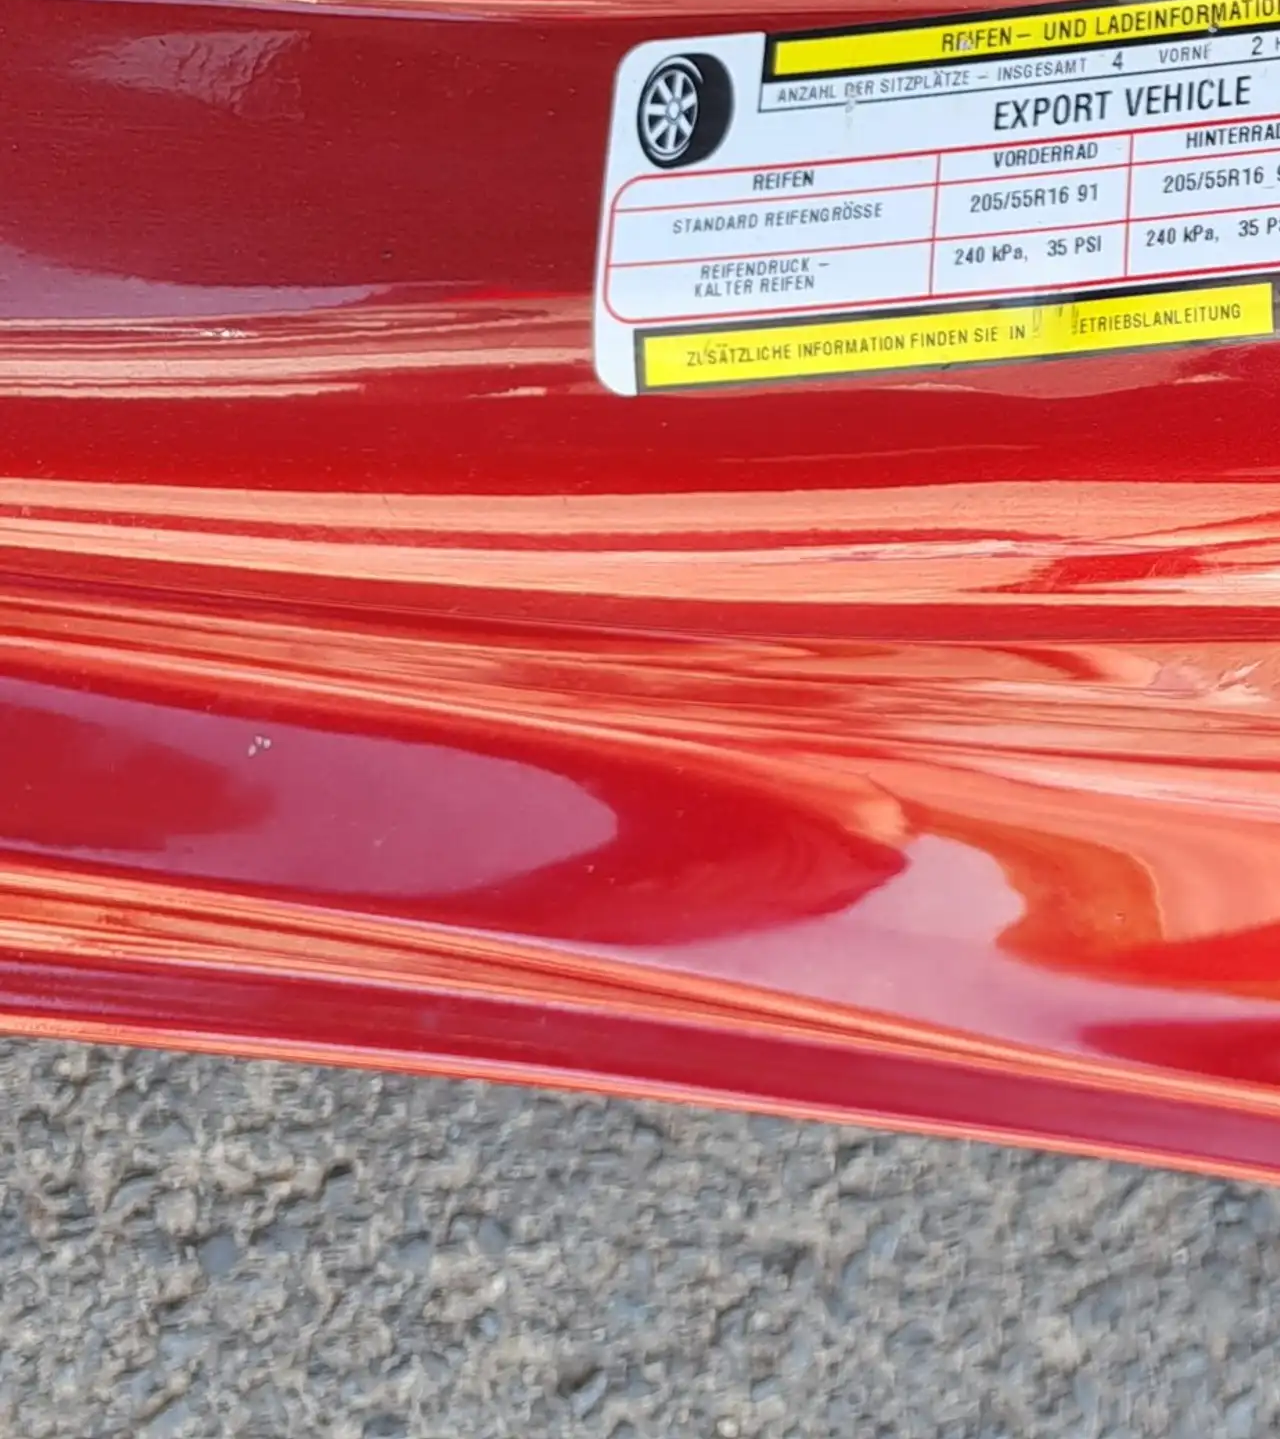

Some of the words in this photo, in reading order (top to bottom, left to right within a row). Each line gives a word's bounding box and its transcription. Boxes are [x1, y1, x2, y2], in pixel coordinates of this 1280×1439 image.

[1044, 18, 1087, 41] UND
[777, 83, 836, 103] ANZAHL
[844, 78, 874, 98] DER
[880, 70, 971, 94] SITZPLÄTZE
[997, 57, 1087, 82] INSGESAMT
[1112, 51, 1124, 71] 4
[1251, 35, 1264, 56] 2
[993, 90, 1113, 131] EXPORT
[1125, 75, 1252, 116] VEHICLE
[993, 141, 1098, 169] VORDERRAD
[752, 169, 815, 192] REIFEN
[1163, 165, 1264, 194] 205/55R16
[970, 185, 1070, 214] 205/55R16
[1077, 182, 1098, 202] 91
[672, 215, 758, 235] STANDARD
[764, 201, 883, 228] REIFENGRÖSSE
[1146, 227, 1177, 248] 240
[1183, 222, 1220, 245] kPa,
[1238, 218, 1259, 238] 35
[954, 246, 985, 266] 240
[992, 243, 1028, 263] kPa,
[1047, 238, 1067, 257] 35
[1075, 235, 1102, 254] PSI
[699, 257, 810, 279] REIFENDRUCK
[694, 277, 753, 298] KALTER
[759, 274, 815, 294] REIFEN
[798, 335, 905, 358] INFORMATION
[911, 329, 968, 350] FINDEN
[974, 326, 998, 343] SIE
[1009, 325, 1026, 340] IN
